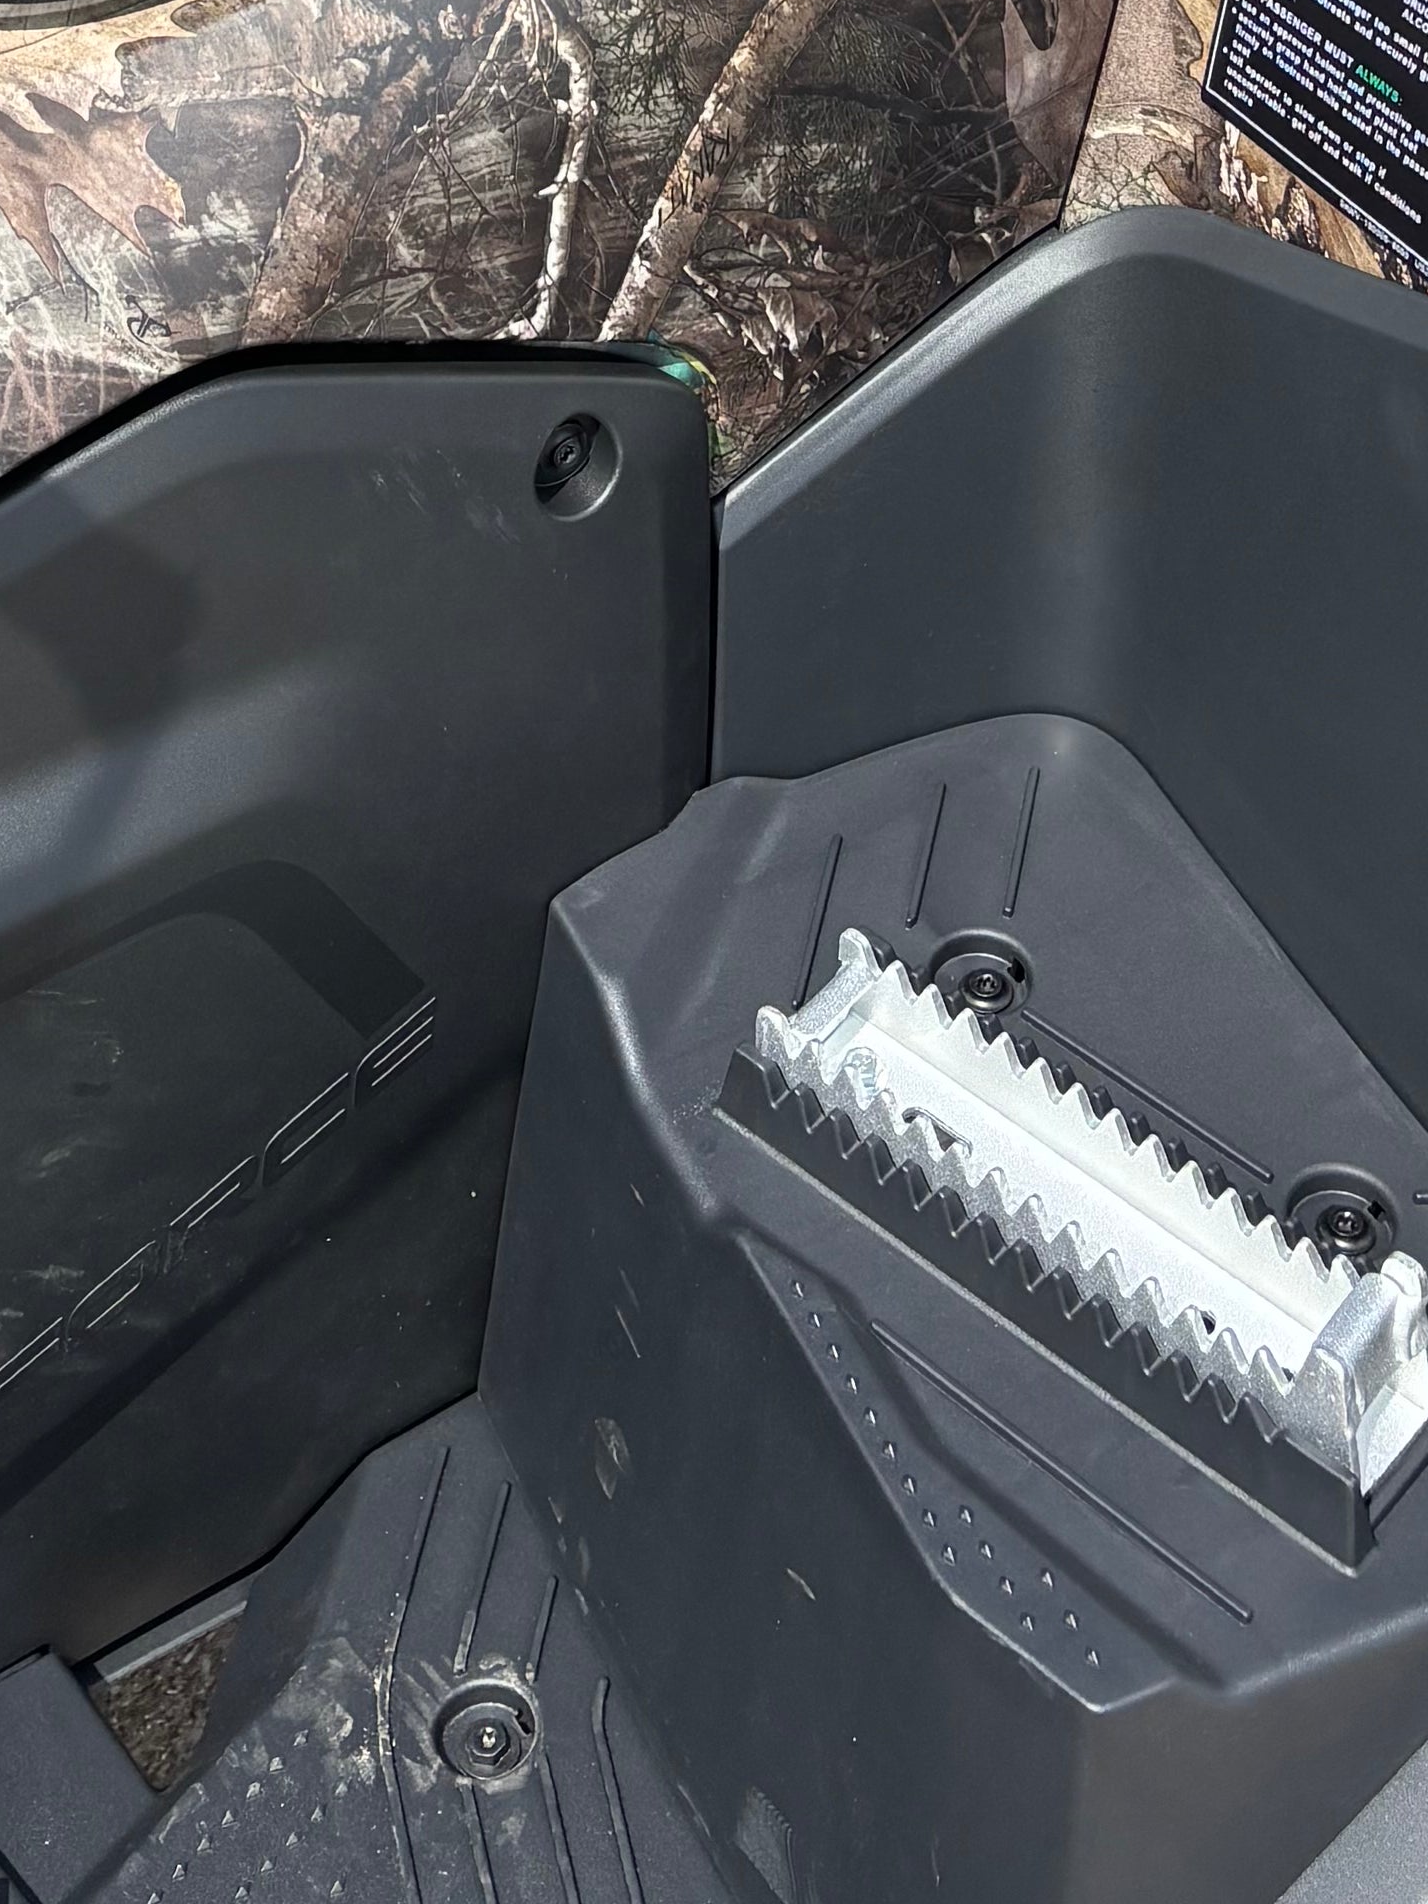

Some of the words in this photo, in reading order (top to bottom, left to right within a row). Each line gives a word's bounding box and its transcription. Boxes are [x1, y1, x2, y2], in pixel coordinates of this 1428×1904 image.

[1353, 21, 1373, 40] and
[1375, 36, 1417, 73] securely
[1373, 16, 1390, 35] too
[1393, 32, 1421, 57] small
[1324, 39, 1353, 67] MUST
[1355, 64, 1402, 105] ALWAYS:
